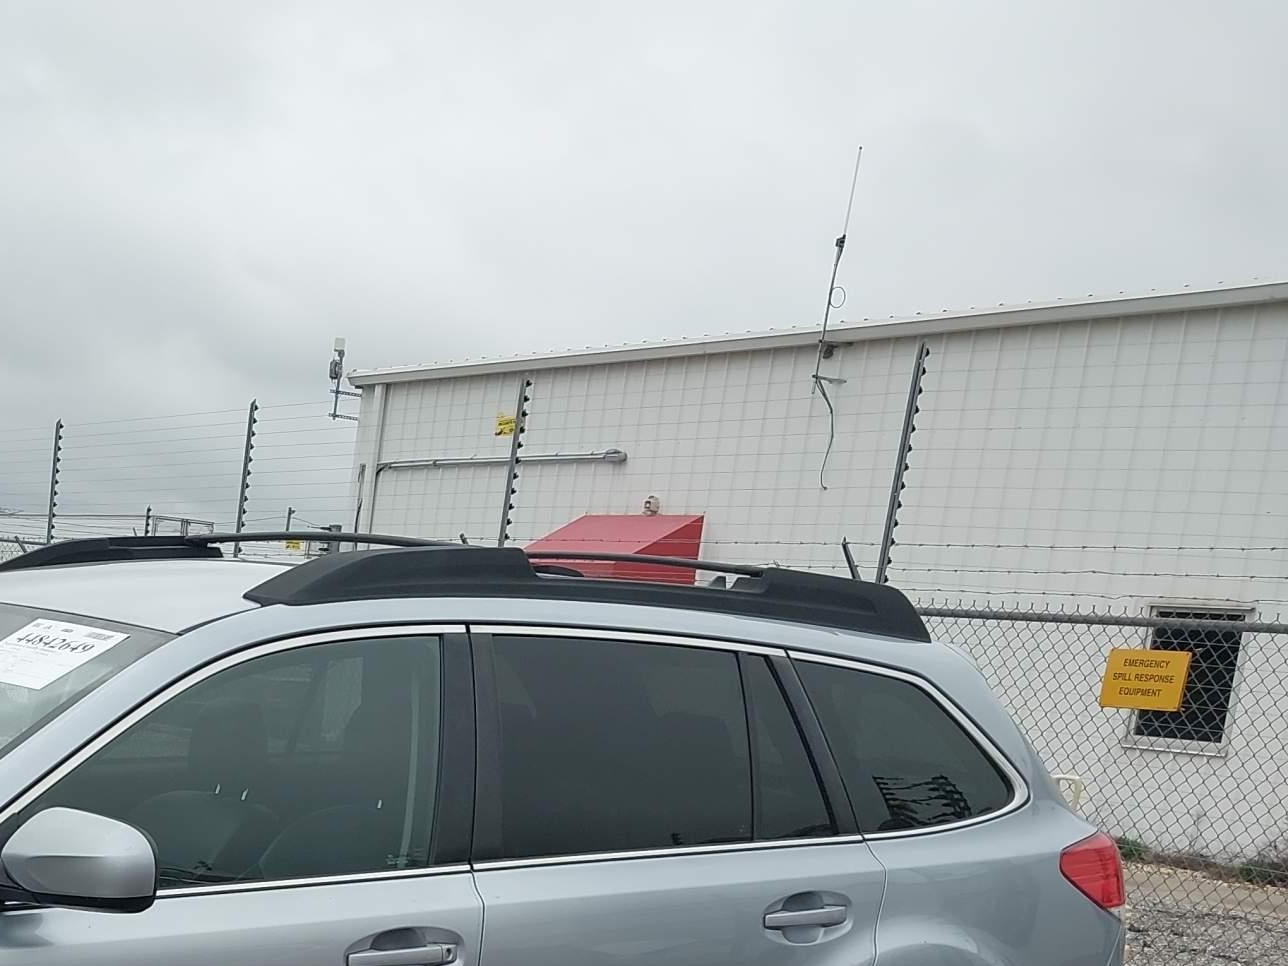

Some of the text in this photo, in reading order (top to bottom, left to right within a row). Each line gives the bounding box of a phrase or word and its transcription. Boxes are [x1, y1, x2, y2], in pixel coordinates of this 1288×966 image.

[16, 632, 96, 653] 44842649
[1123, 658, 1171, 669] EMERGENCY
[1113, 672, 1175, 683] SPILL RESPONSE
[1118, 686, 1162, 697] EQUIPMENT
